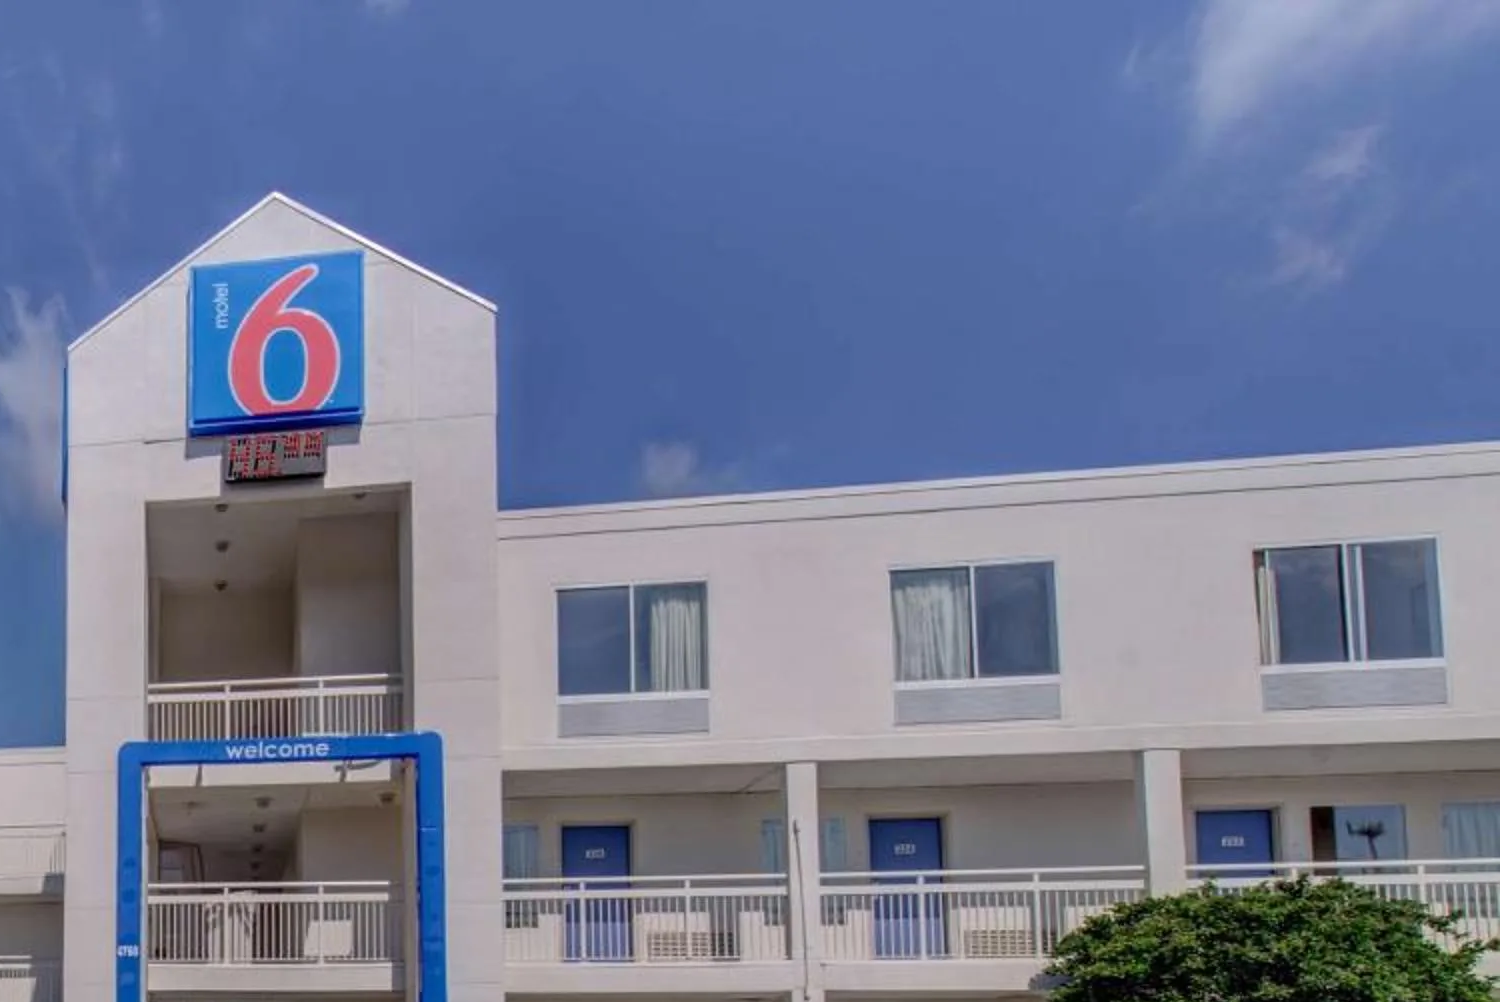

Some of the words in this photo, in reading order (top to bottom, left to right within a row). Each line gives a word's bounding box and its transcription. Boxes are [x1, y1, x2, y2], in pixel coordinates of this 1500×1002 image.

[211, 283, 229, 329] motel
[228, 263, 341, 416] 6
[226, 741, 330, 759] welcome
